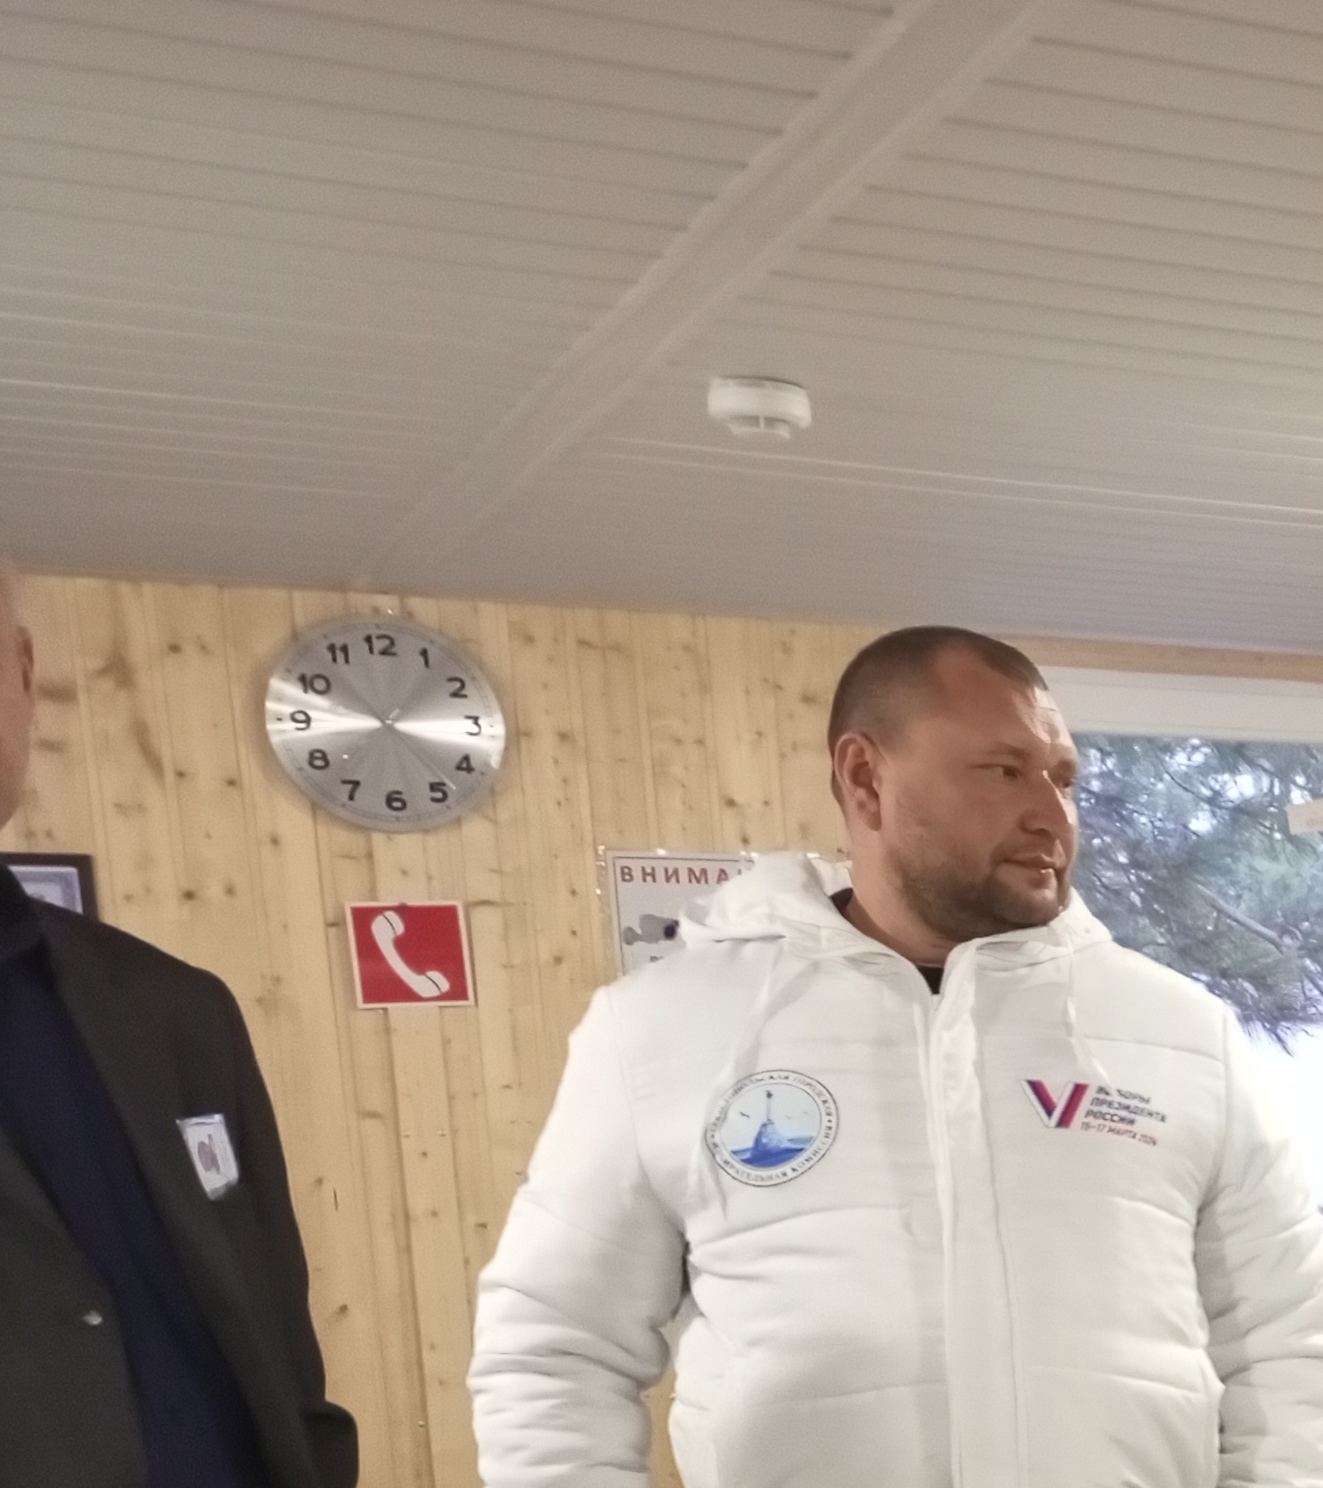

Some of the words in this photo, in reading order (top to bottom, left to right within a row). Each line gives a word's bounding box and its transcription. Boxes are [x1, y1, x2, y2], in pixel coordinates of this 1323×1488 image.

[326, 643, 350, 665] 11
[364, 634, 397, 657] 12
[419, 647, 430, 668] 1
[298, 673, 331, 695] 10
[446, 677, 468, 698] 2
[290, 710, 311, 731] 9
[463, 715, 482, 736] 3
[308, 749, 330, 770] 8
[455, 754, 475, 774] 4
[340, 779, 361, 801] 7
[428, 781, 449, 803] 5
[385, 790, 407, 812] 6
[619, 865, 742, 885] ВНИМА
[1096, 1085, 1152, 1105] ВОРЫ
[1084, 1109, 1136, 1126] РОССИИ
[1090, 1097, 1168, 1123] ПРЕЗИДЕНТА
[1106, 1125, 1138, 1140] МАРТА
[1138, 1132, 1158, 1147] 2024
